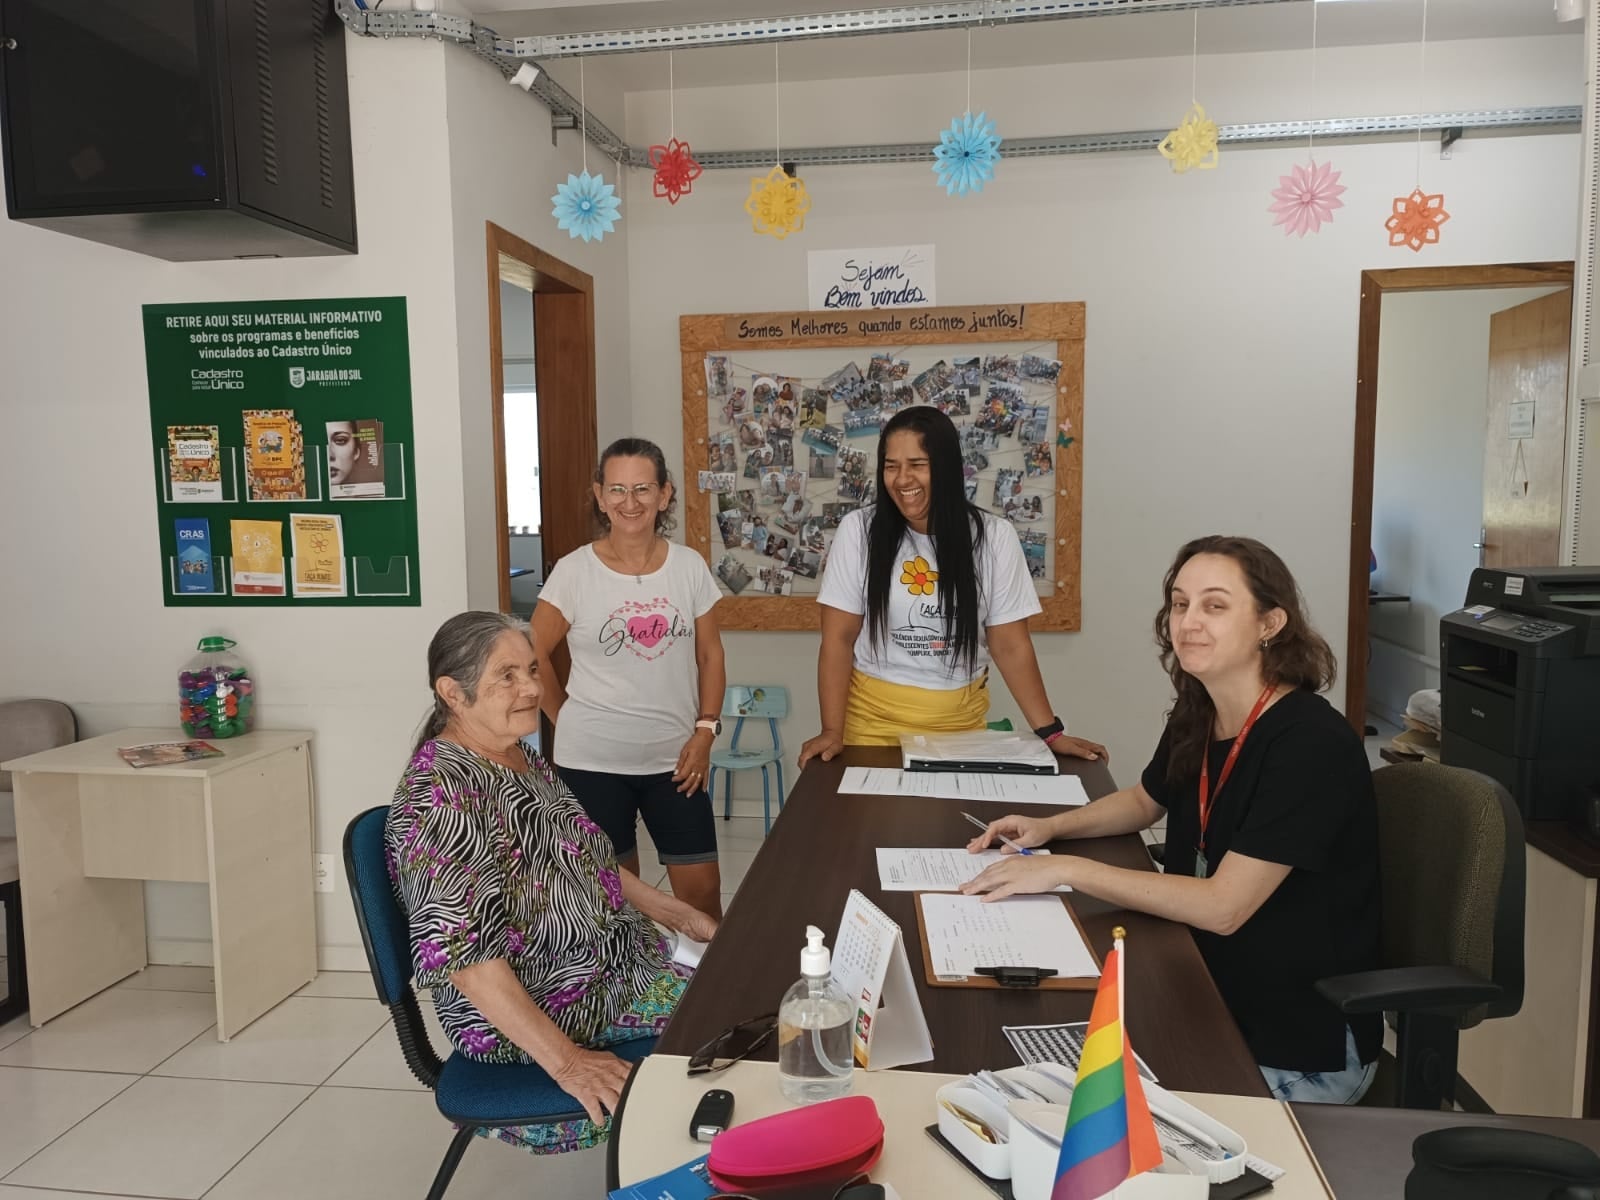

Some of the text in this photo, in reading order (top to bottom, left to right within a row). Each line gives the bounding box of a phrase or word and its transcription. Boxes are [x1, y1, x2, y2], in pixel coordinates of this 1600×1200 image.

[841, 260, 904, 291] Sejam
[824, 285, 862, 308] Bem
[166, 310, 383, 328] RETIRE AQUI SEU MATERIAL INFORMATIVO
[738, 304, 1025, 339] Somos Melhores quando estamos juntos!
[190, 331, 219, 343] sobre
[221, 333, 234, 342] os
[236, 331, 293, 345] programas
[295, 330, 302, 340] e
[199, 341, 352, 359] vinculados ao Cadastro Único
[191, 368, 244, 379] Cadastro
[348, 368, 363, 381] SUL
[179, 530, 204, 539] CRAS
